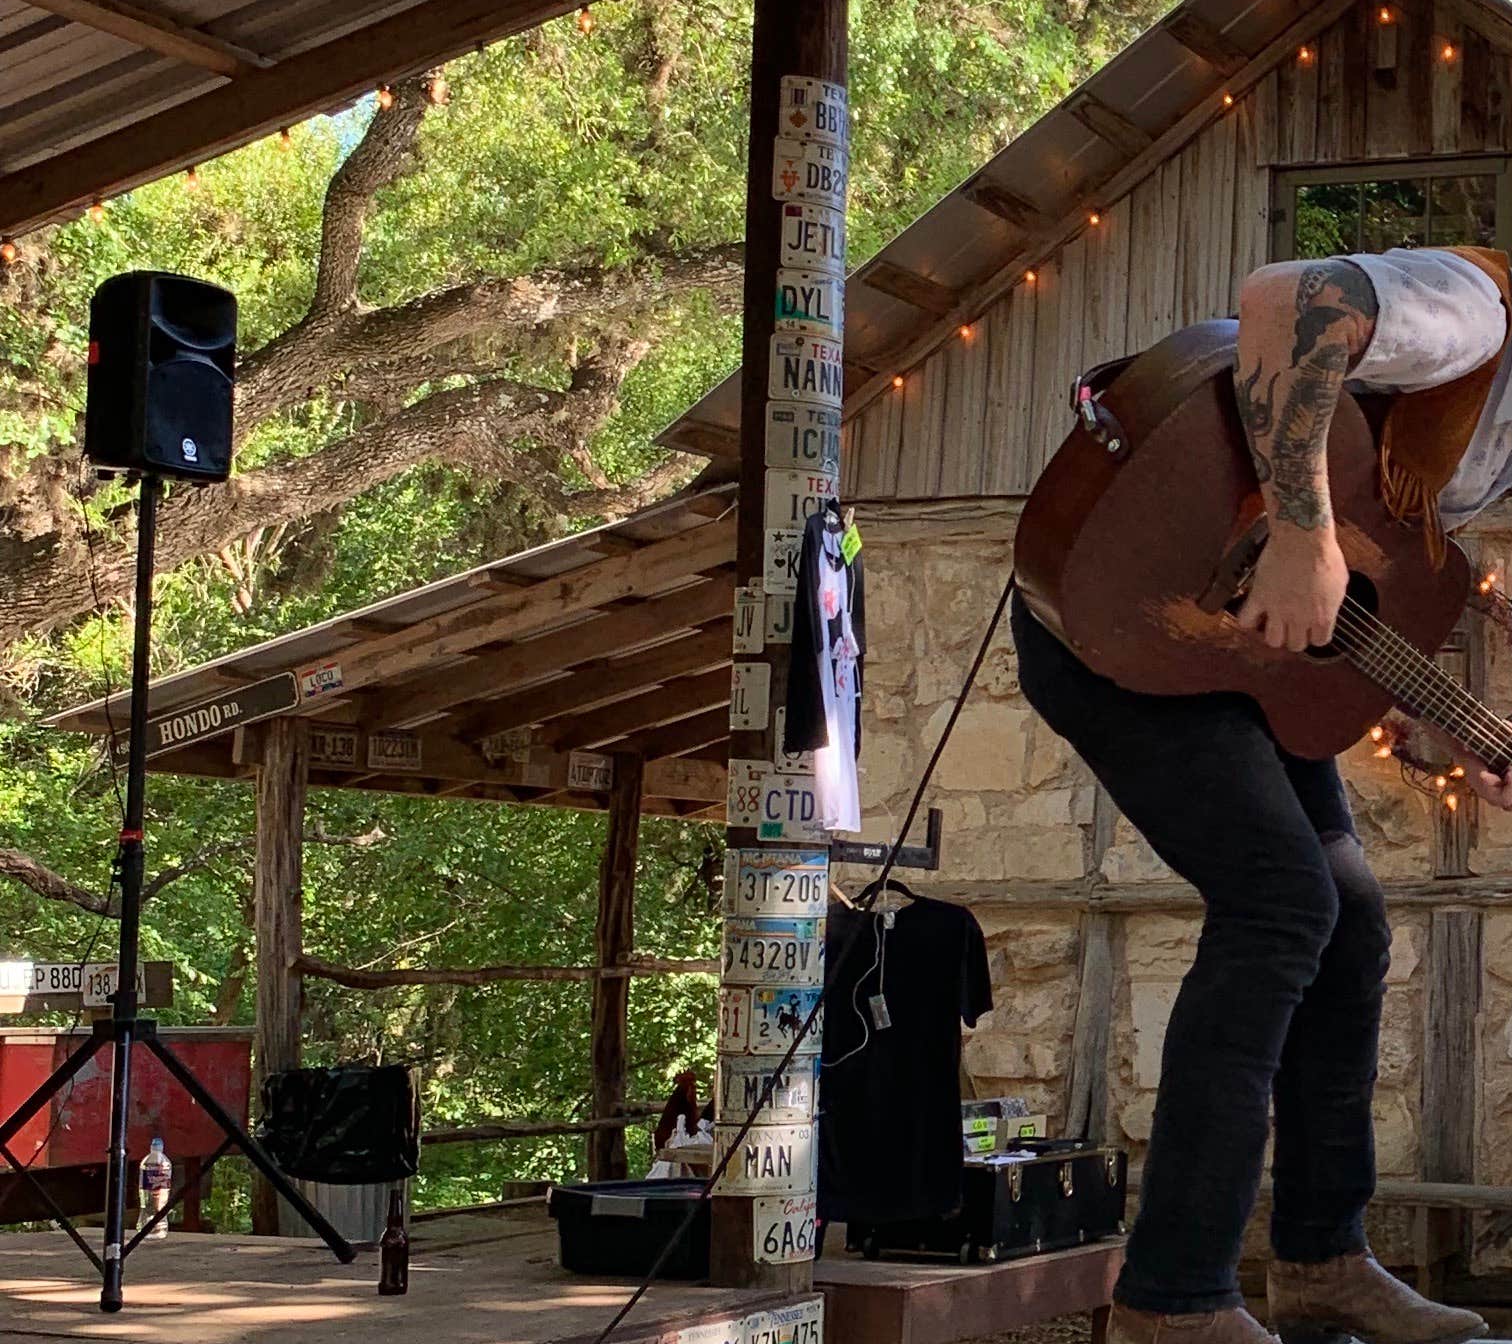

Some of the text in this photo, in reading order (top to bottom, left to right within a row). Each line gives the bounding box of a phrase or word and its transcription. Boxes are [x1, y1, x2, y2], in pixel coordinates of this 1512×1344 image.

[158, 705, 222, 746] HONDO
[765, 789, 815, 822] CTD
[745, 1145, 792, 1178] MAN
